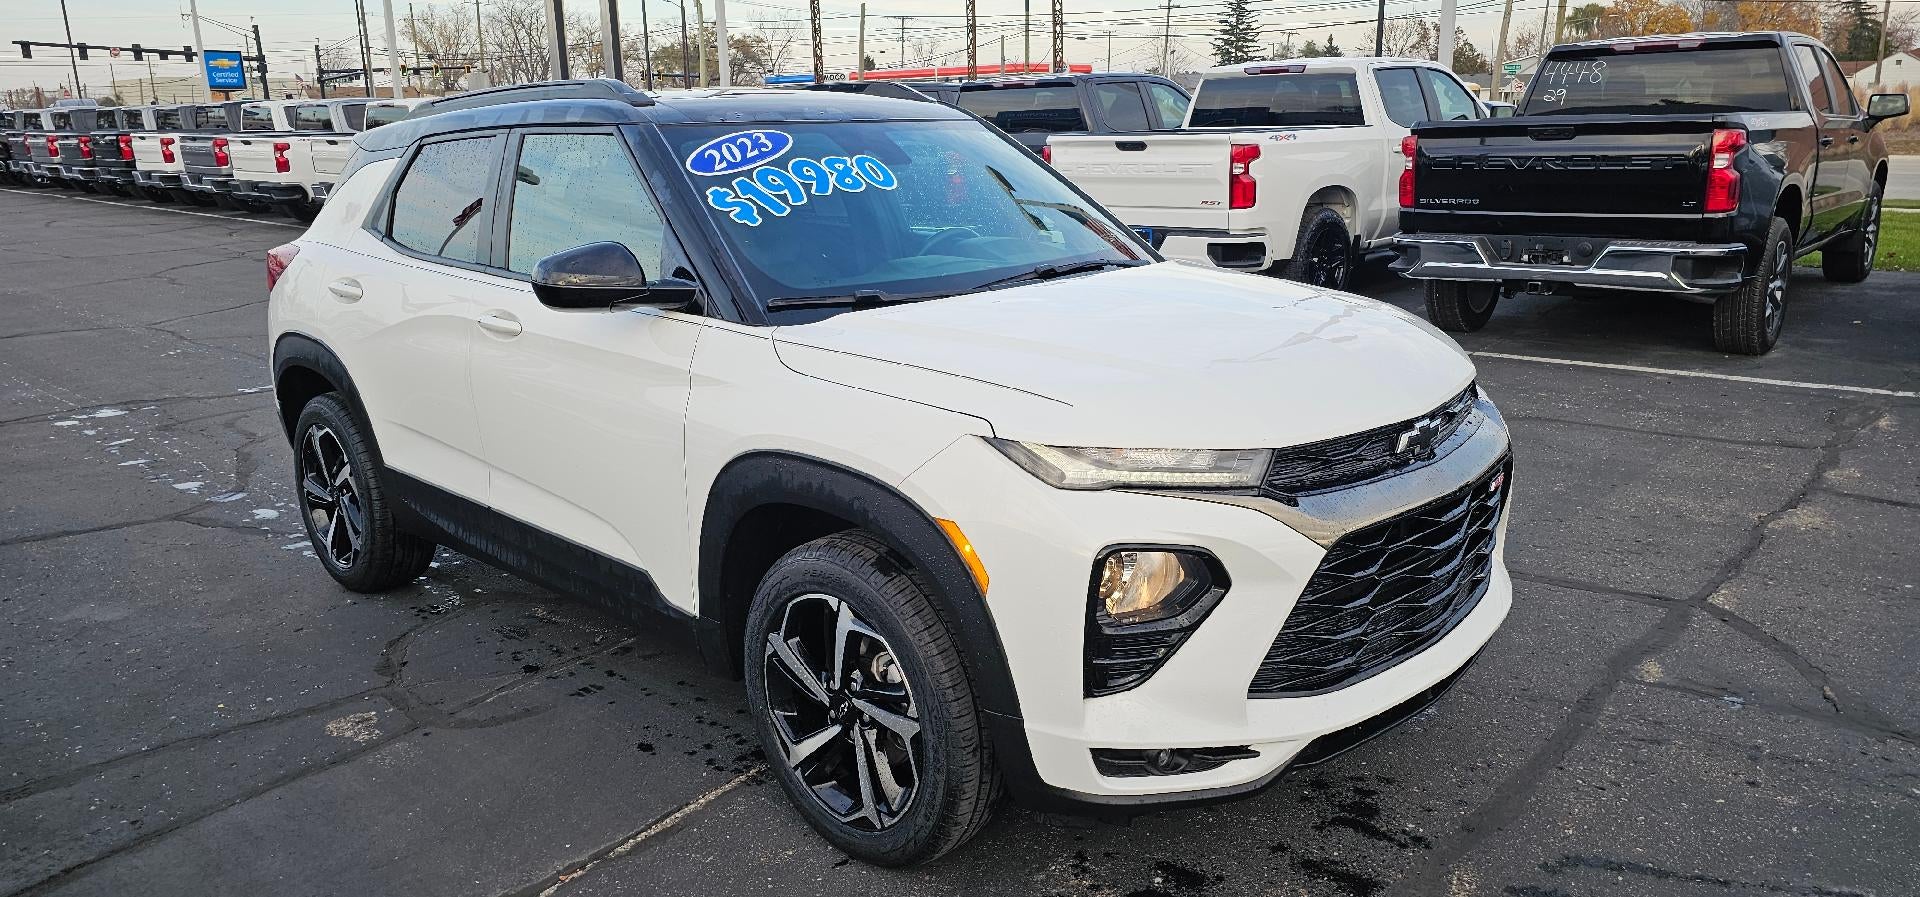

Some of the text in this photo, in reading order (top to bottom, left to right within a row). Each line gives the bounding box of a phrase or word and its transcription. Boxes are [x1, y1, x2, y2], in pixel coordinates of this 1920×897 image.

[704, 132, 773, 171] 2023
[1431, 156, 1688, 170] CHEVROLET
[706, 154, 898, 226] $19980
